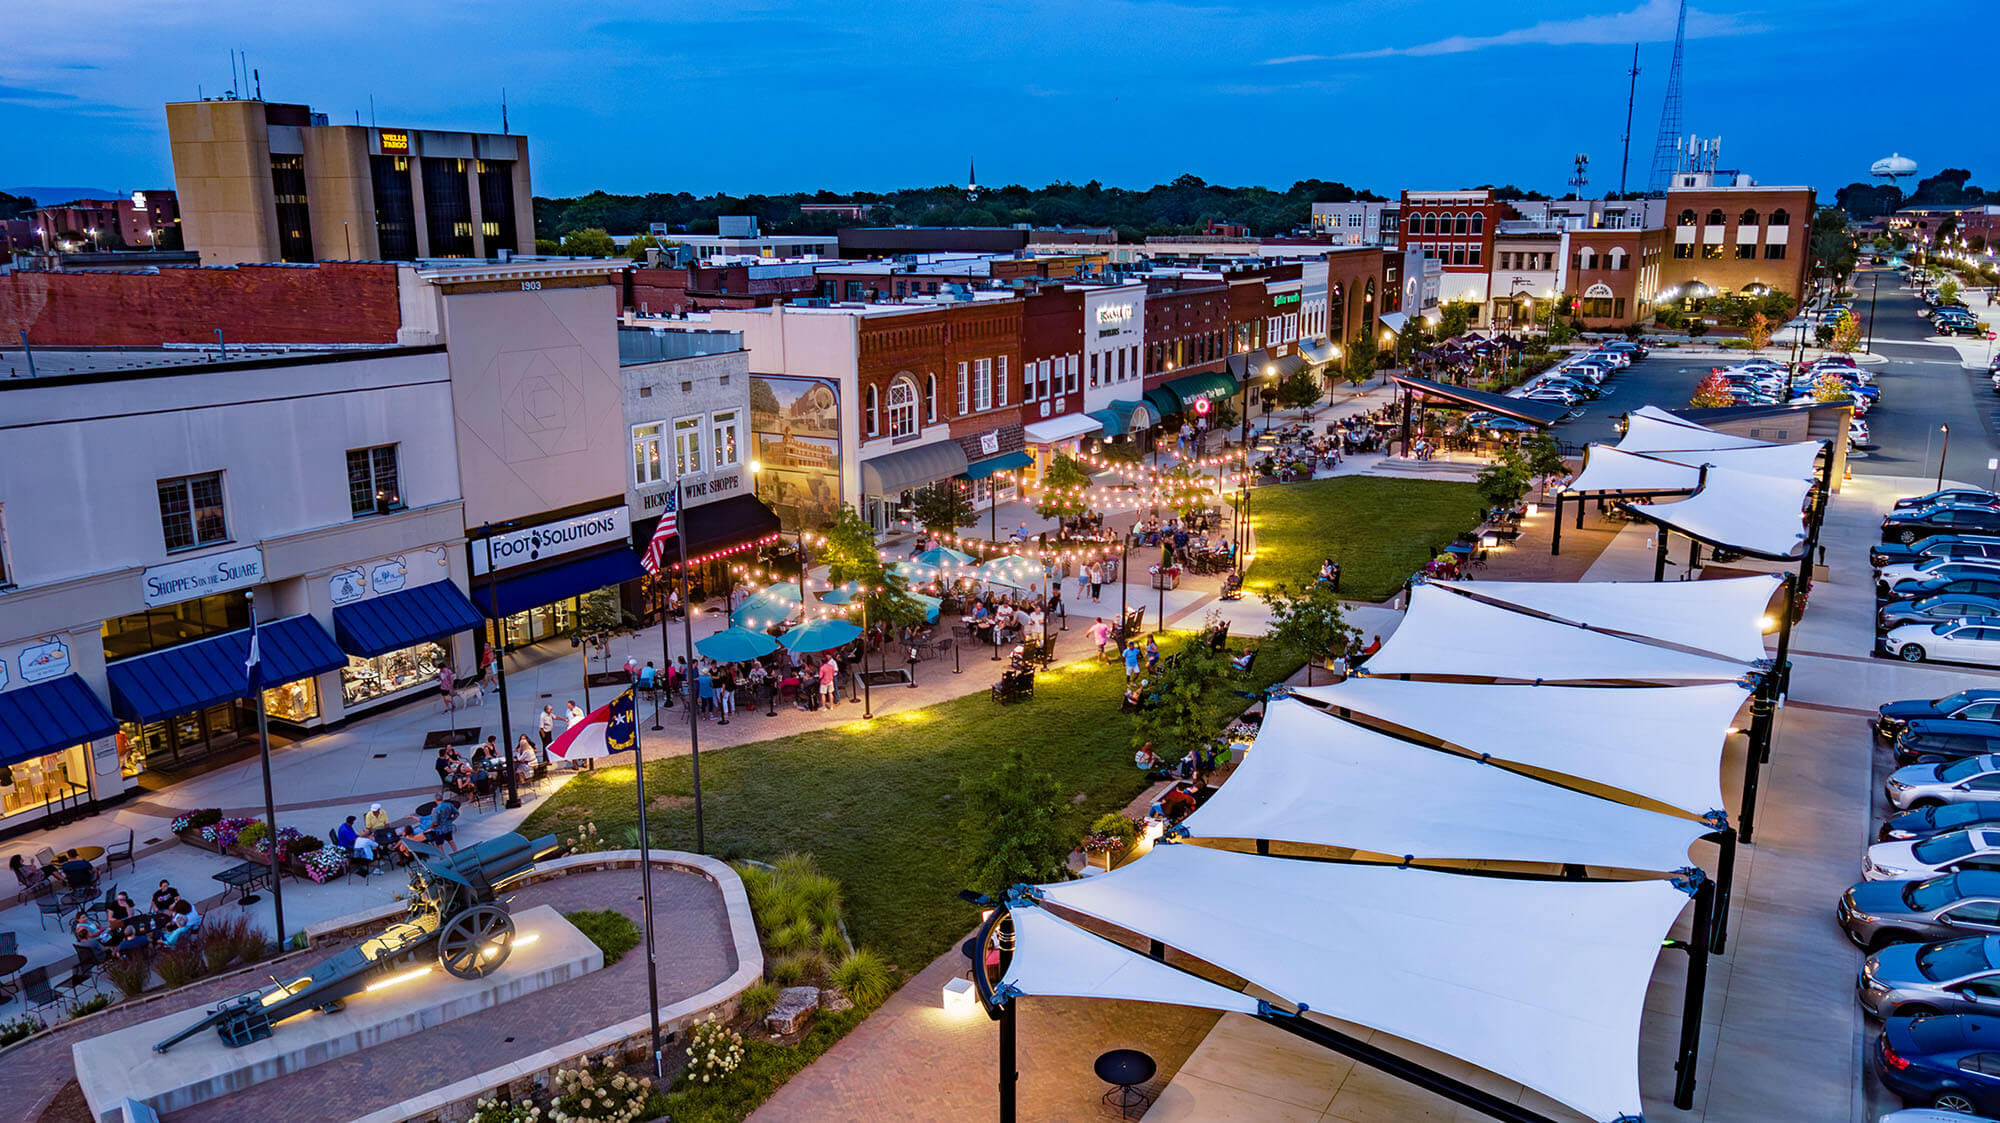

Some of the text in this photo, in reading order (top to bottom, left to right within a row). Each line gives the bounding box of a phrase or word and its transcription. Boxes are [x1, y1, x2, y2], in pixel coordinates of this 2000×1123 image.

[382, 134, 407, 142] WELLS
[383, 141, 407, 149] FARGO
[521, 280, 542, 291] 1903
[643, 475, 739, 510] HICKO WINE SHOPPE
[493, 518, 614, 559] FOOT SOLUTIONS
[217, 561, 260, 582] SQUARE
